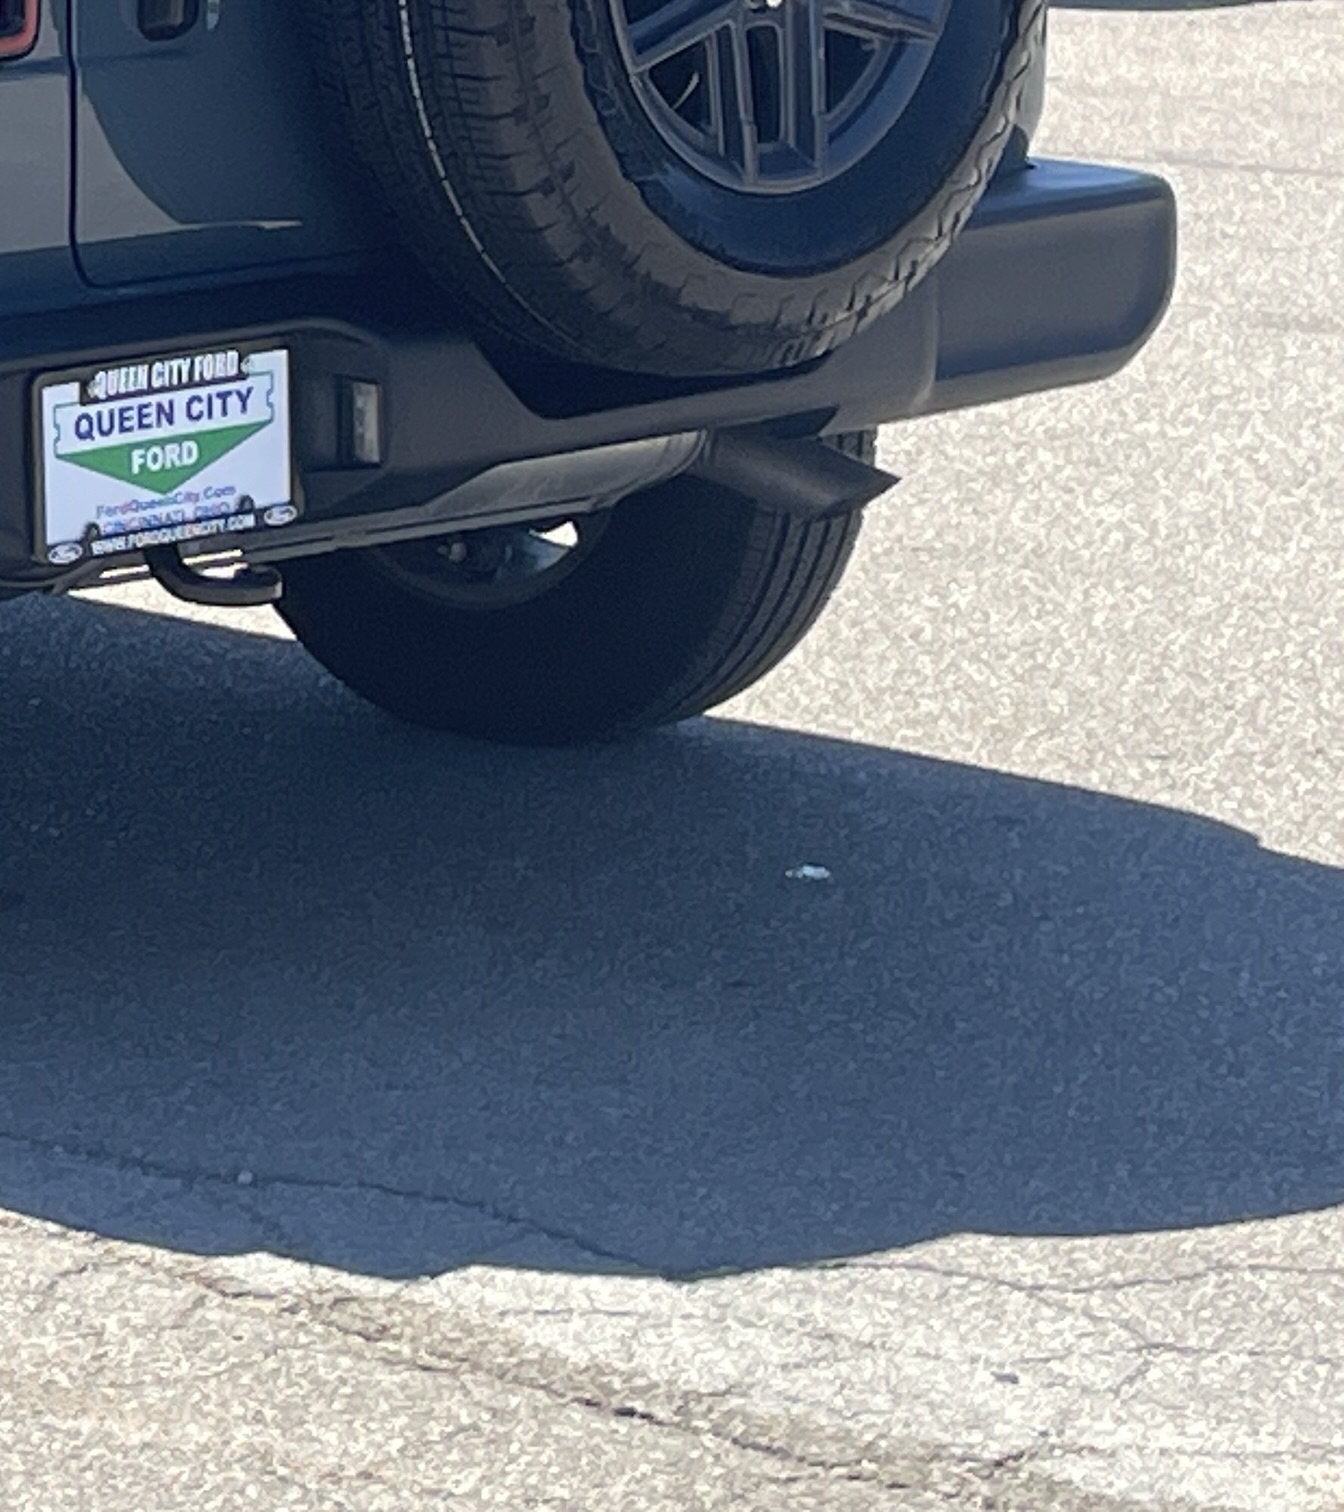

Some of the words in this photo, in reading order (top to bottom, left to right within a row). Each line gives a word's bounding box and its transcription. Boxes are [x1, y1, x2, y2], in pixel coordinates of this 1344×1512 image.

[95, 364, 150, 400] QUEEN
[151, 356, 191, 389] CITY
[194, 350, 240, 382] FORD
[74, 399, 175, 441] QUEEN
[185, 387, 255, 423] CITY
[131, 440, 199, 475] FORD
